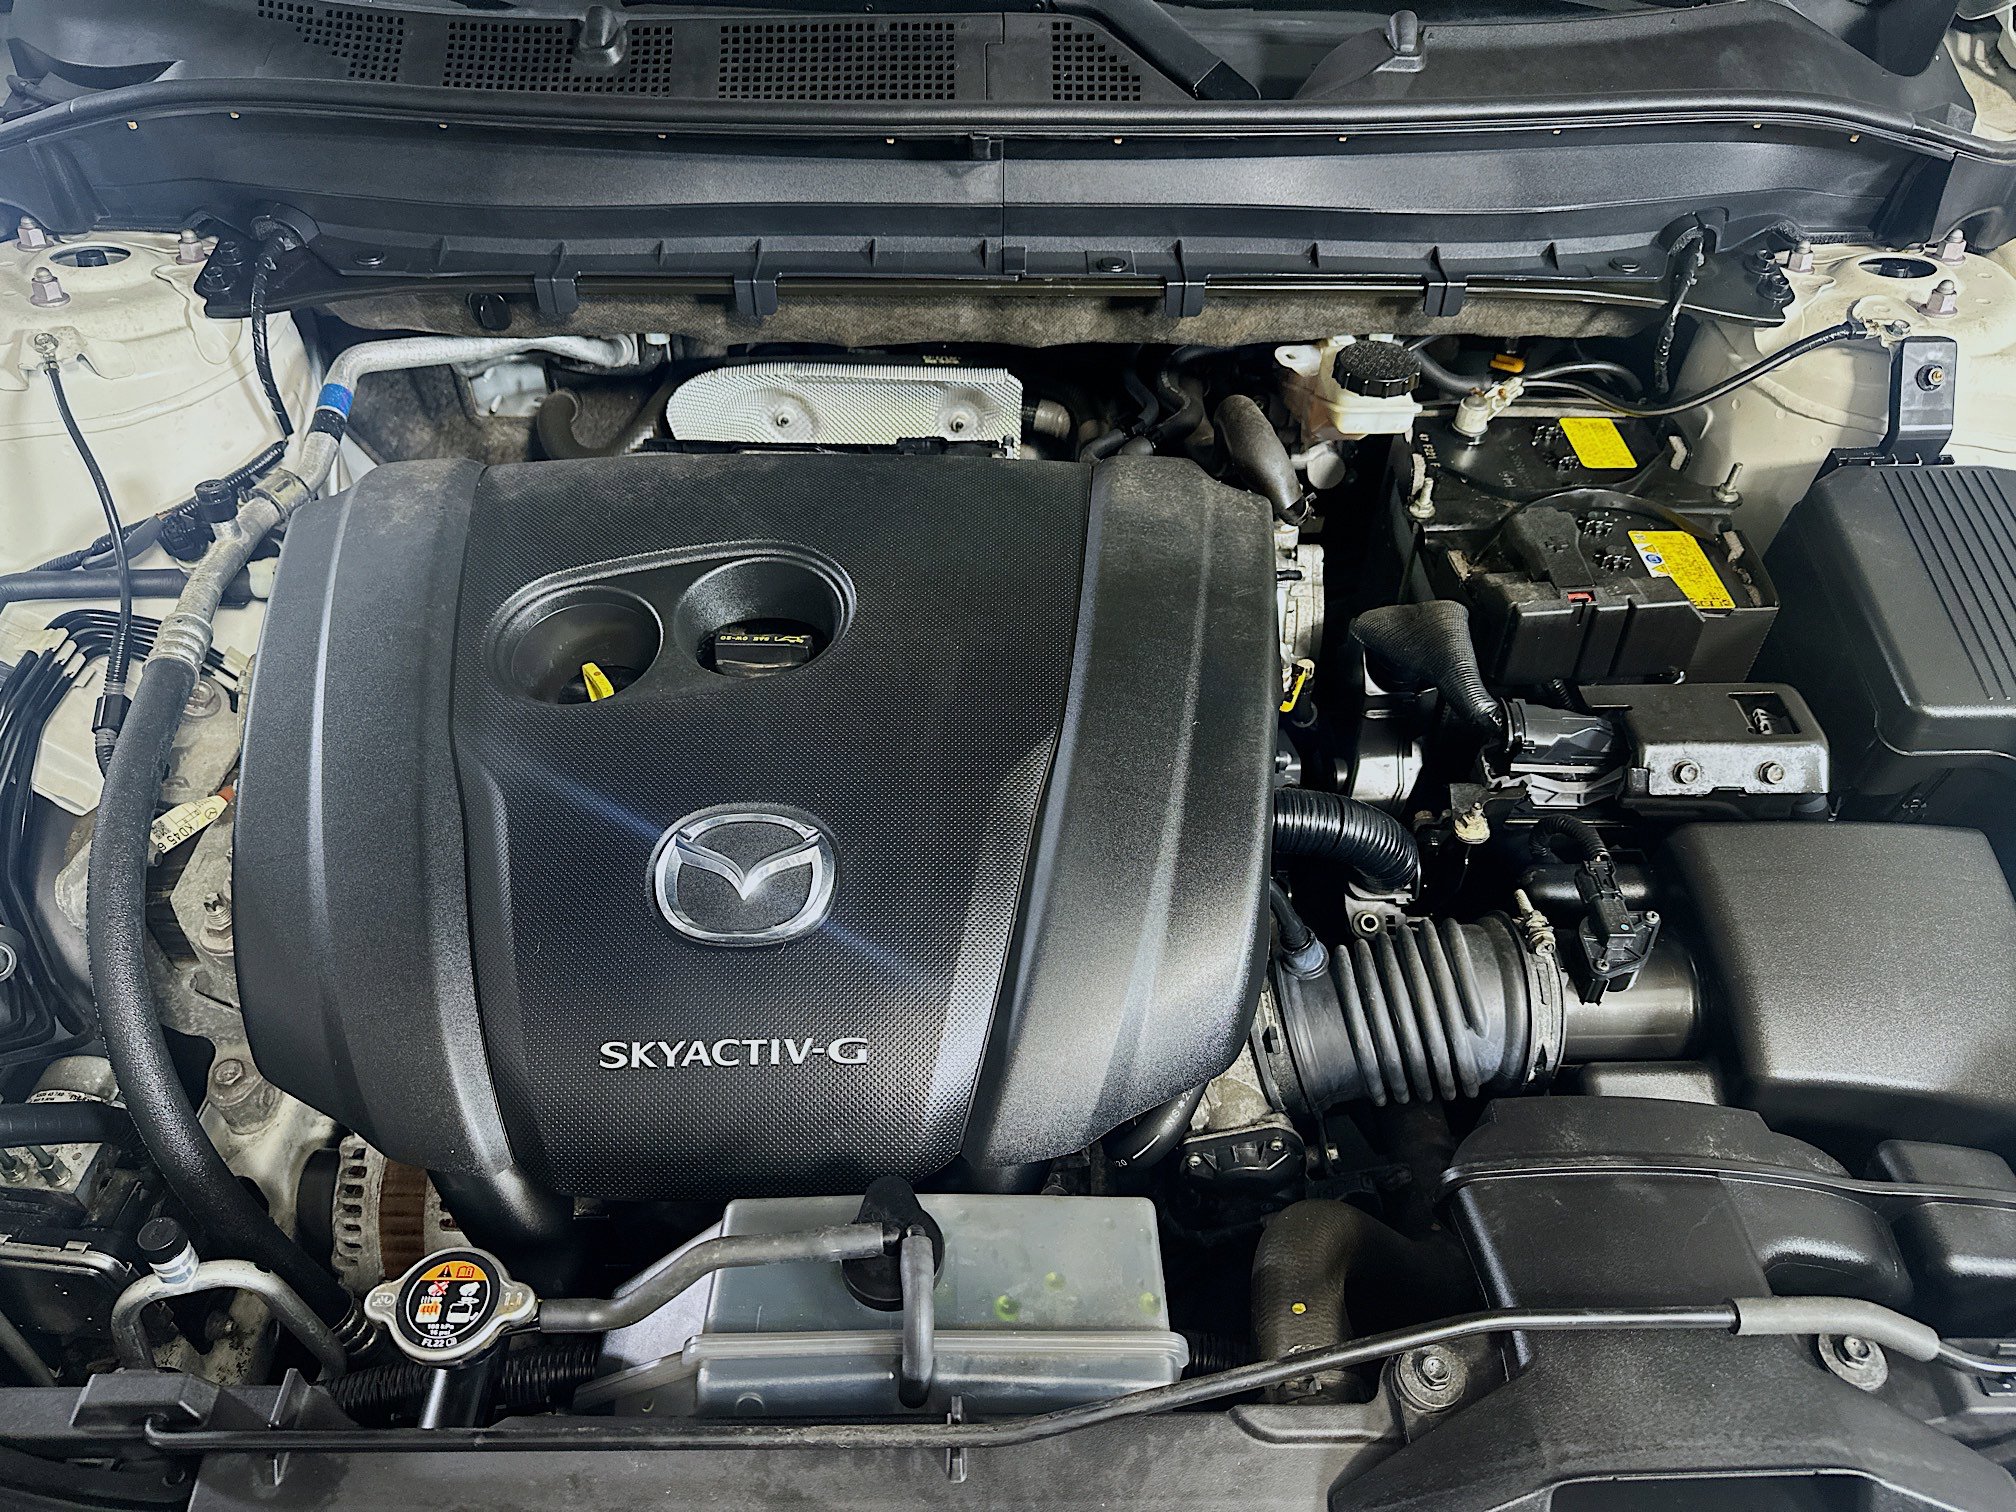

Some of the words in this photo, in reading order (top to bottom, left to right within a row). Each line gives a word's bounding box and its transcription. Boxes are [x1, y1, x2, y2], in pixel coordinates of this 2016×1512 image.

[166, 823, 195, 846] KD45
[599, 1037, 868, 1069] SKYACTIV-G
[421, 1337, 445, 1348] FL22
